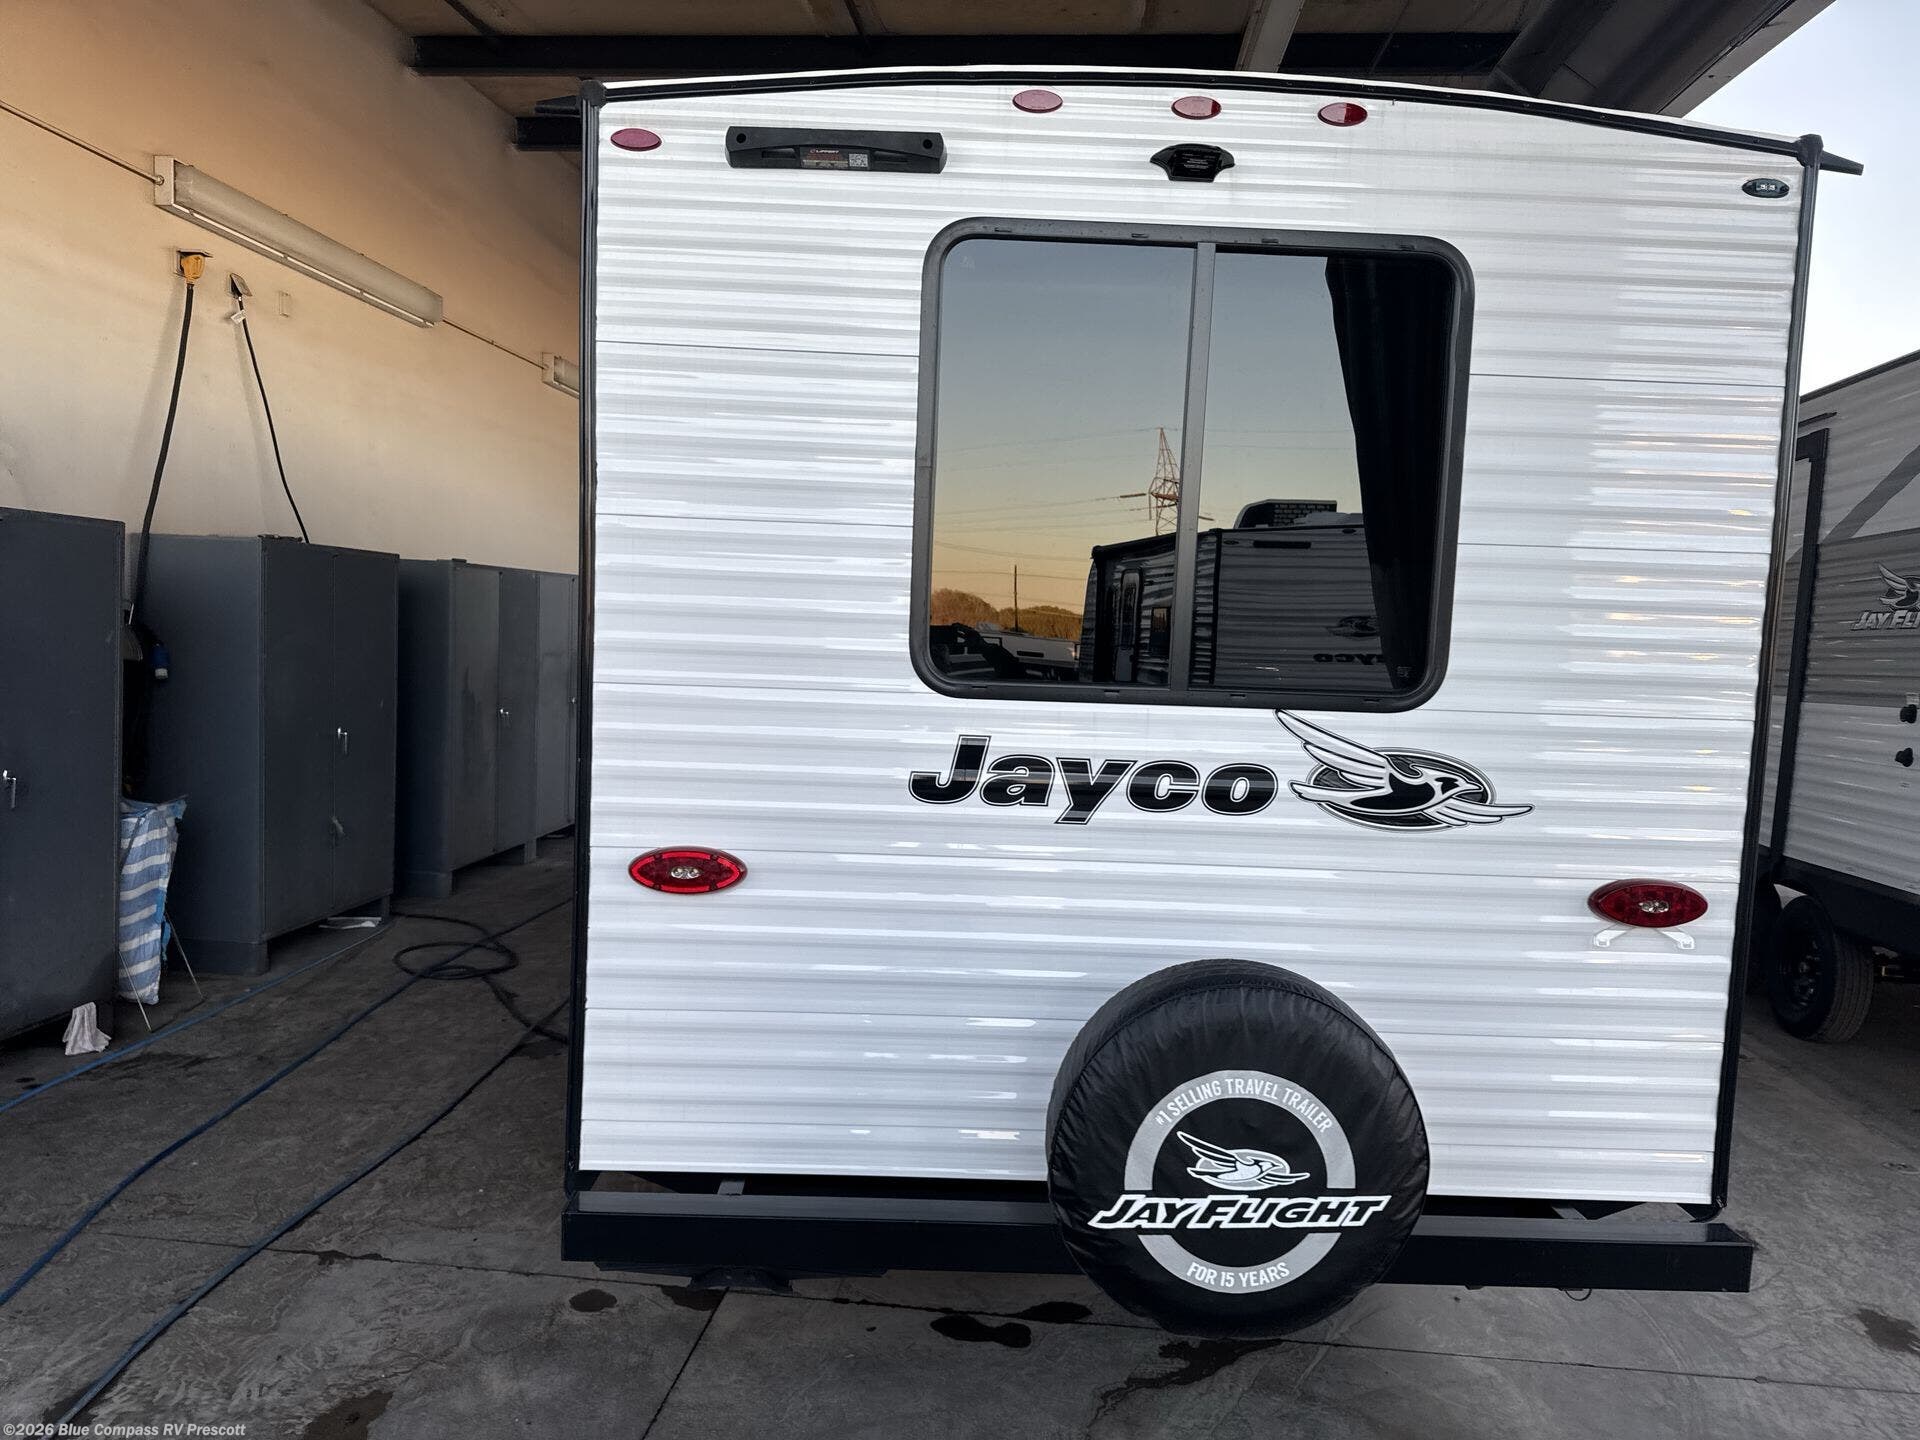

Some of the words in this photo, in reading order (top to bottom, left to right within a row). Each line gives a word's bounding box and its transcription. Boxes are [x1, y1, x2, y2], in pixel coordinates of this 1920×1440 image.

[908, 734, 1279, 825] Jayco
[1154, 1110, 1170, 1126] #1
[1167, 1079, 1222, 1116] SELLING
[1225, 1078, 1279, 1100] TRAVEL
[1283, 1087, 1333, 1133] TRAILER
[1186, 1261, 1217, 1287] FOR
[1220, 1270, 1235, 1287] 15
[1239, 1262, 1290, 1288] YEARS
